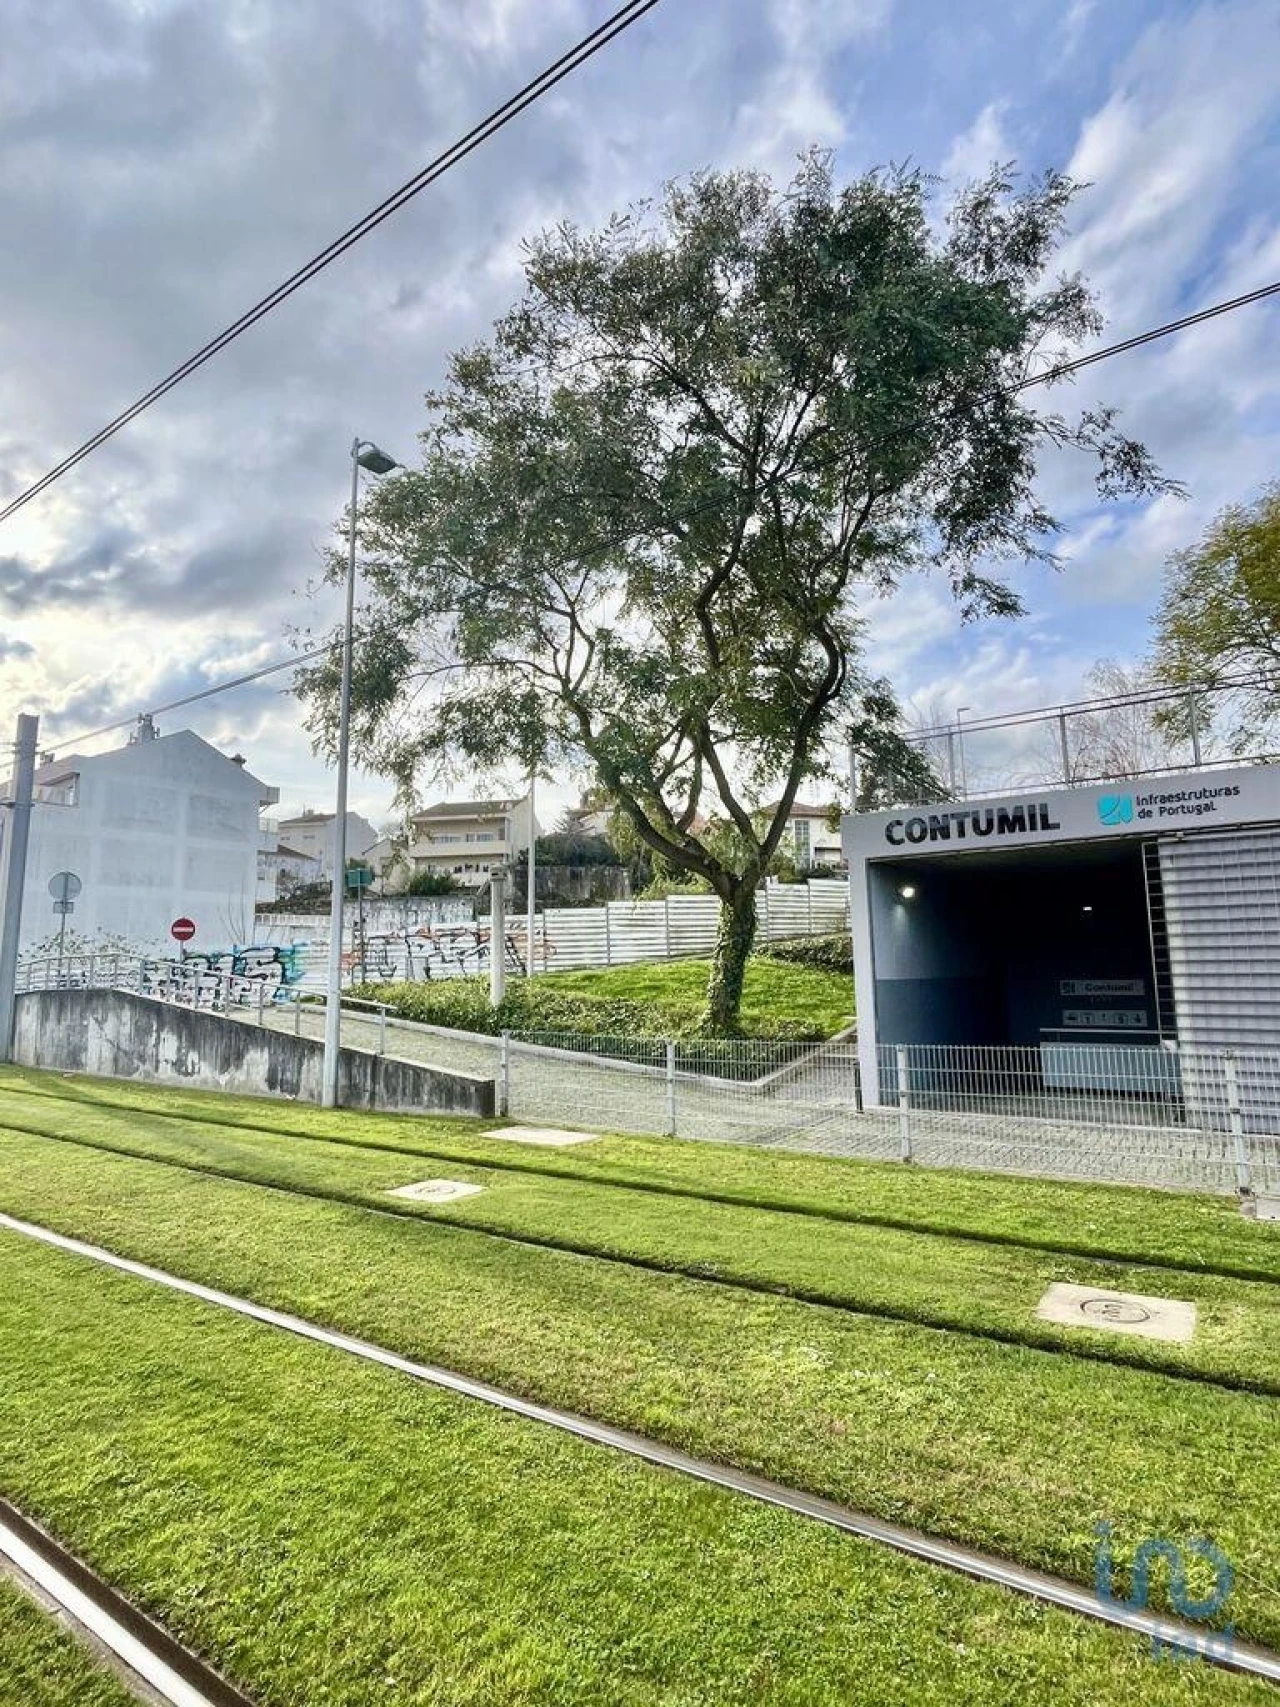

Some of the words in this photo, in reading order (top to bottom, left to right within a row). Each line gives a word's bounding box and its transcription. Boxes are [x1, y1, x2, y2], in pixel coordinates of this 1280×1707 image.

[1136, 786, 1240, 806] Infraestruturas
[1137, 805, 1153, 819] de
[1160, 802, 1217, 817] Portugal
[885, 804, 1060, 846] CONTUMIL
